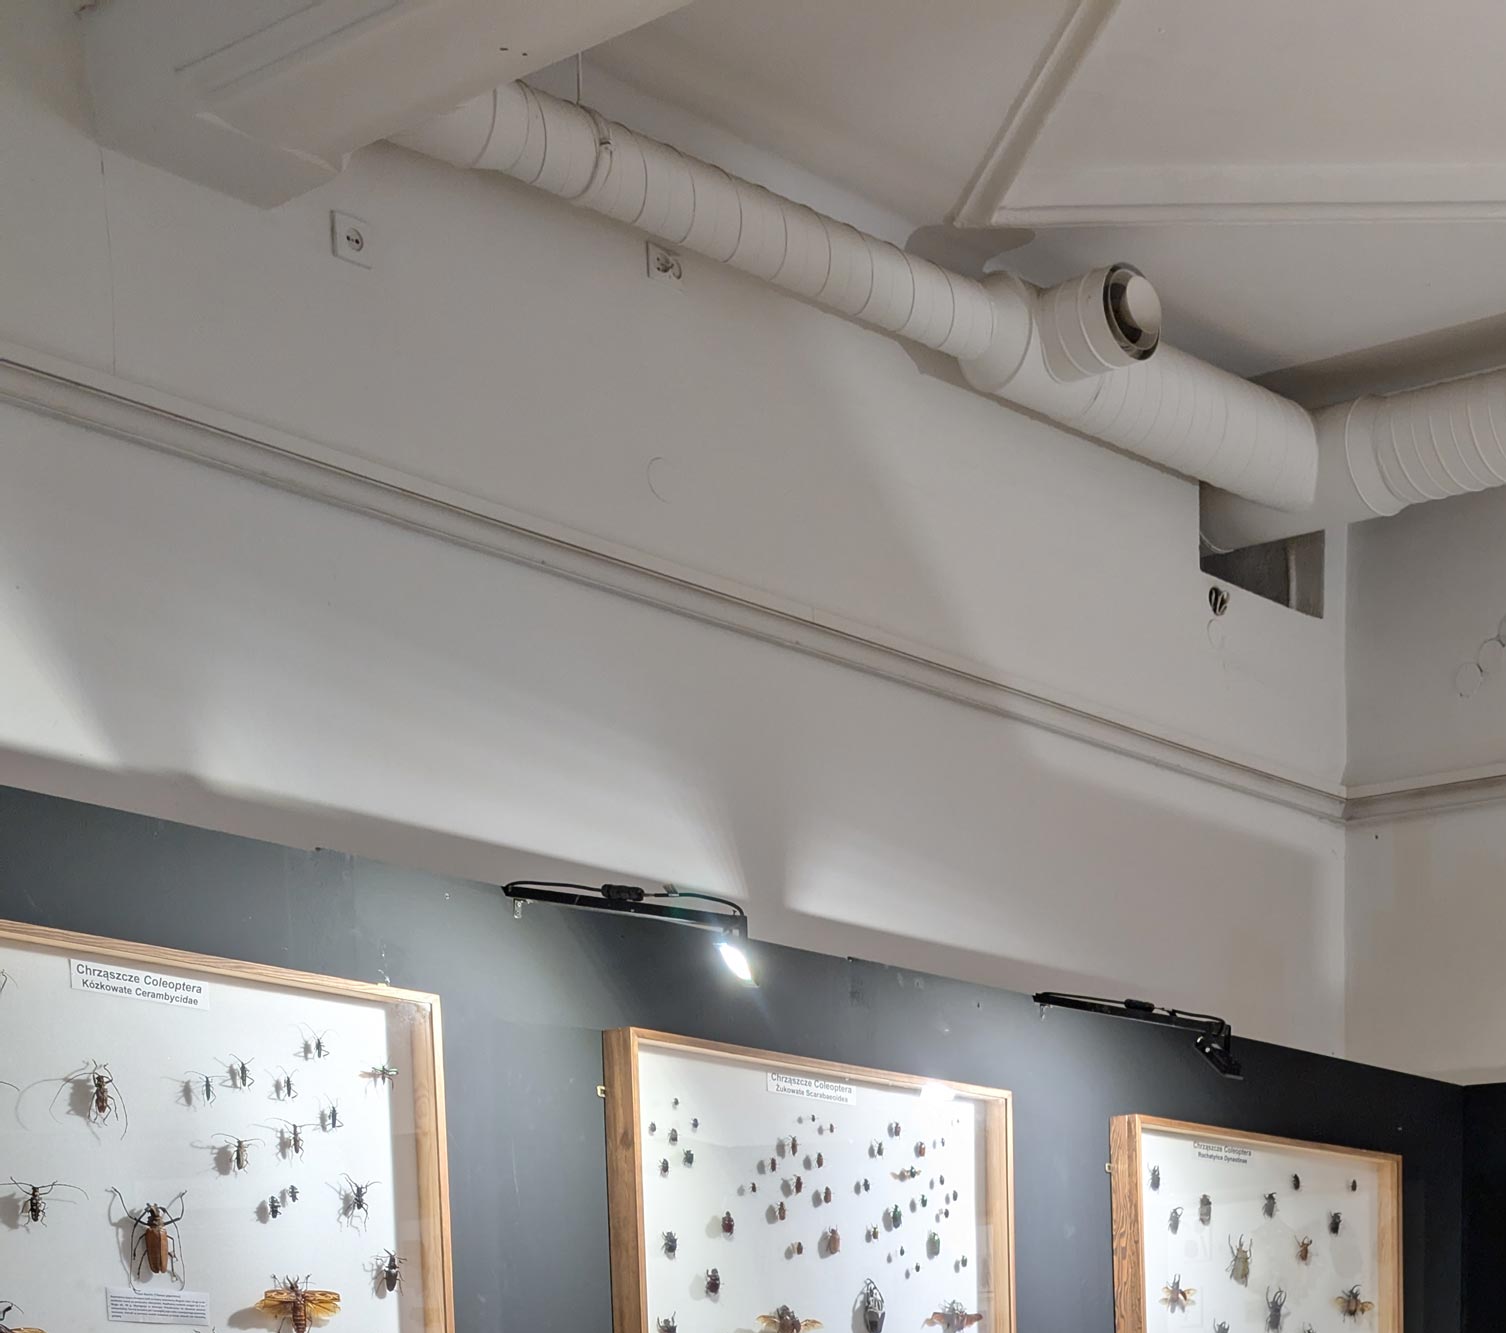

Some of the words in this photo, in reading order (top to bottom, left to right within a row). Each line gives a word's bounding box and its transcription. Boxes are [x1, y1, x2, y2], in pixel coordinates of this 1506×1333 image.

[76, 963, 141, 984] Chrząszcze
[143, 974, 202, 995] Coleoptera
[82, 978, 133, 996] Kózkowate
[135, 987, 199, 1006] Cerambycidae
[771, 1072, 813, 1088] Chrząszcze
[814, 1079, 852, 1095] Coleoptera
